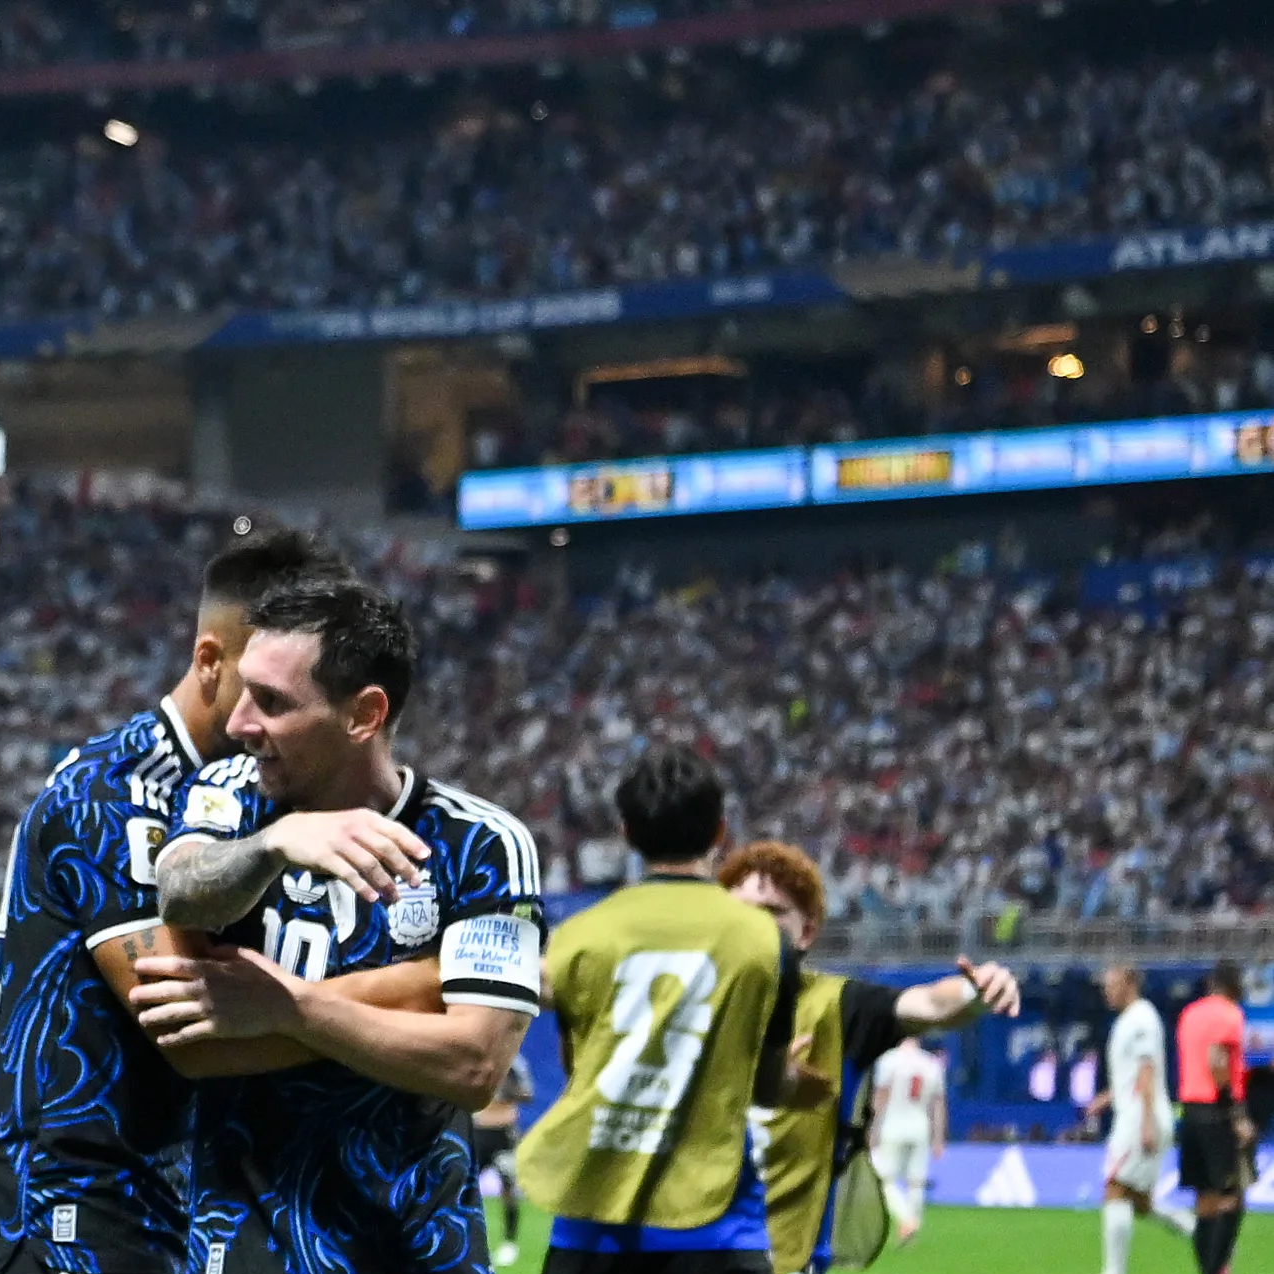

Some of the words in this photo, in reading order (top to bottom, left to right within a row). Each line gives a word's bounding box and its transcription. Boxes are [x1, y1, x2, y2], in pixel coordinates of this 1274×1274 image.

[401, 900, 428, 928] AFA
[464, 919, 519, 936] FOOTBALL
[262, 906, 332, 984] 10
[459, 931, 519, 952] UNITES
[455, 946, 478, 961] the
[481, 948, 522, 967] World
